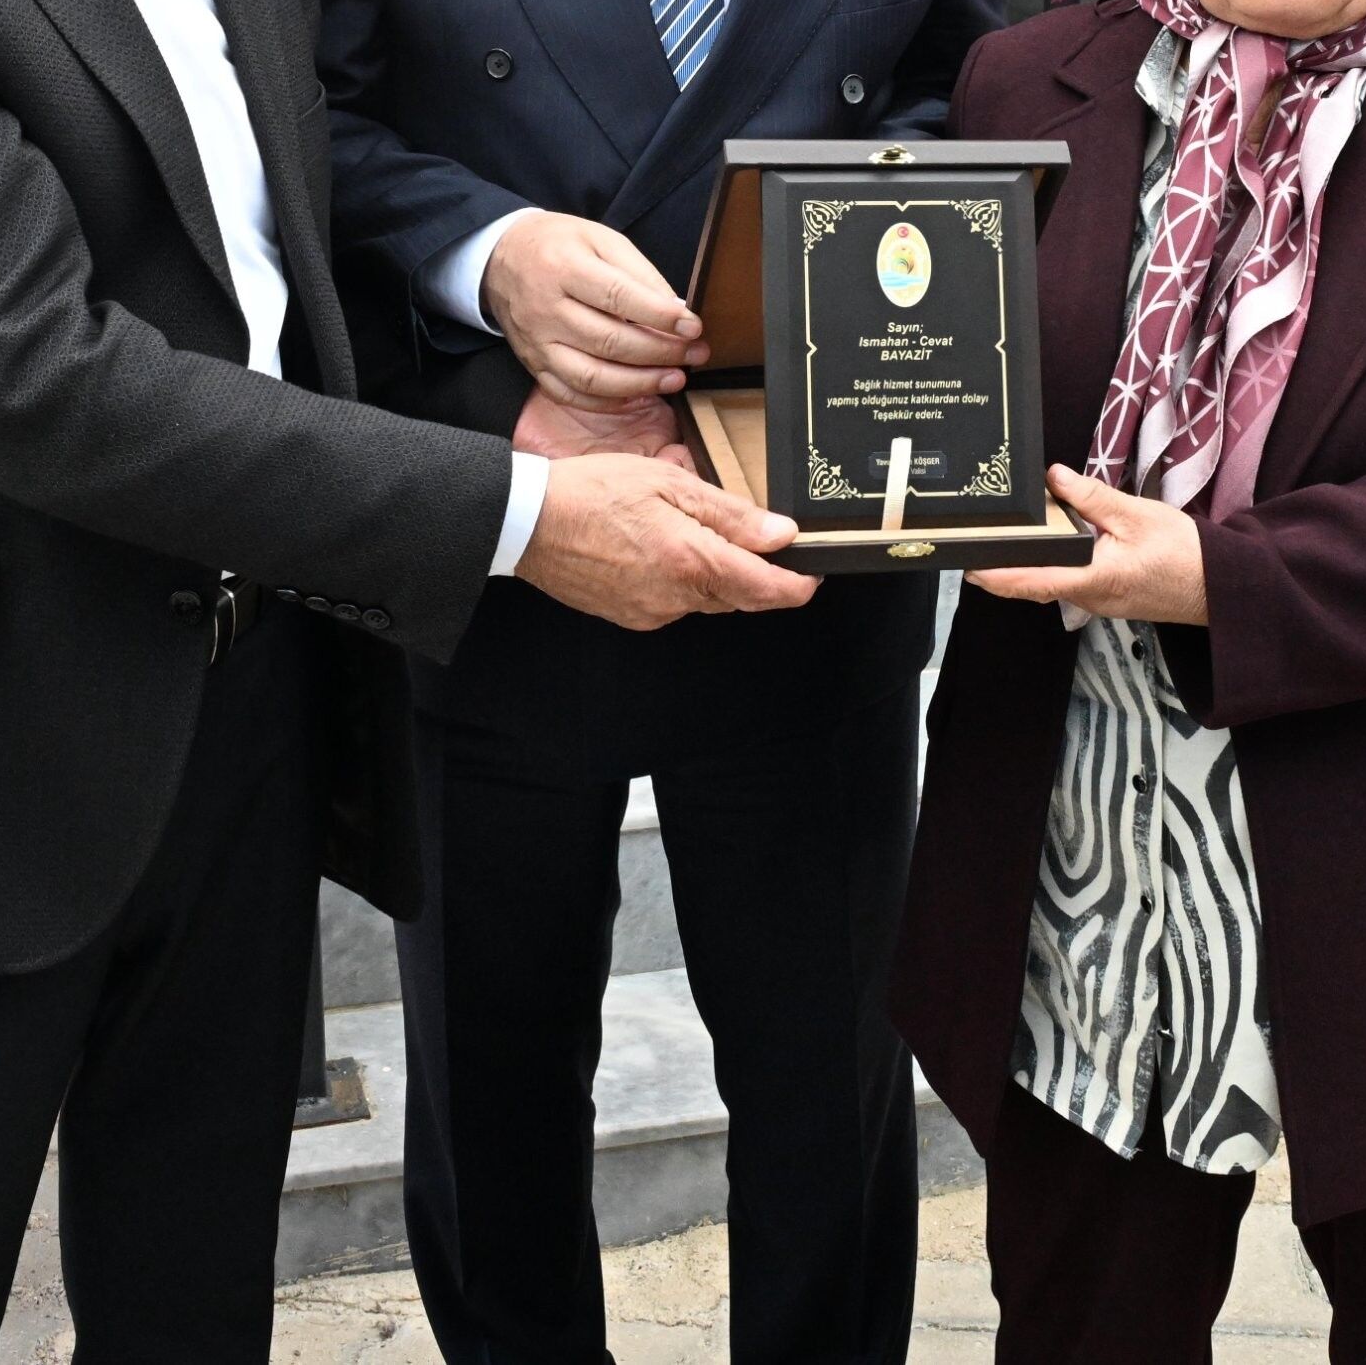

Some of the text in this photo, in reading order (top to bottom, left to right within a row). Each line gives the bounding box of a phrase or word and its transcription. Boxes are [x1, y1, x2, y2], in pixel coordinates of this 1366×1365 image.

[887, 322, 924, 334] Sayın;
[920, 336, 953, 347] Cevat
[881, 347, 932, 361] BAYAZİT
[853, 379, 962, 392] Sağlık hizmet sunumuna
[827, 393, 989, 408] yapmış olduğunuz katkılardan dolayı
[873, 409, 944, 421] Teşekkür ederiz.
